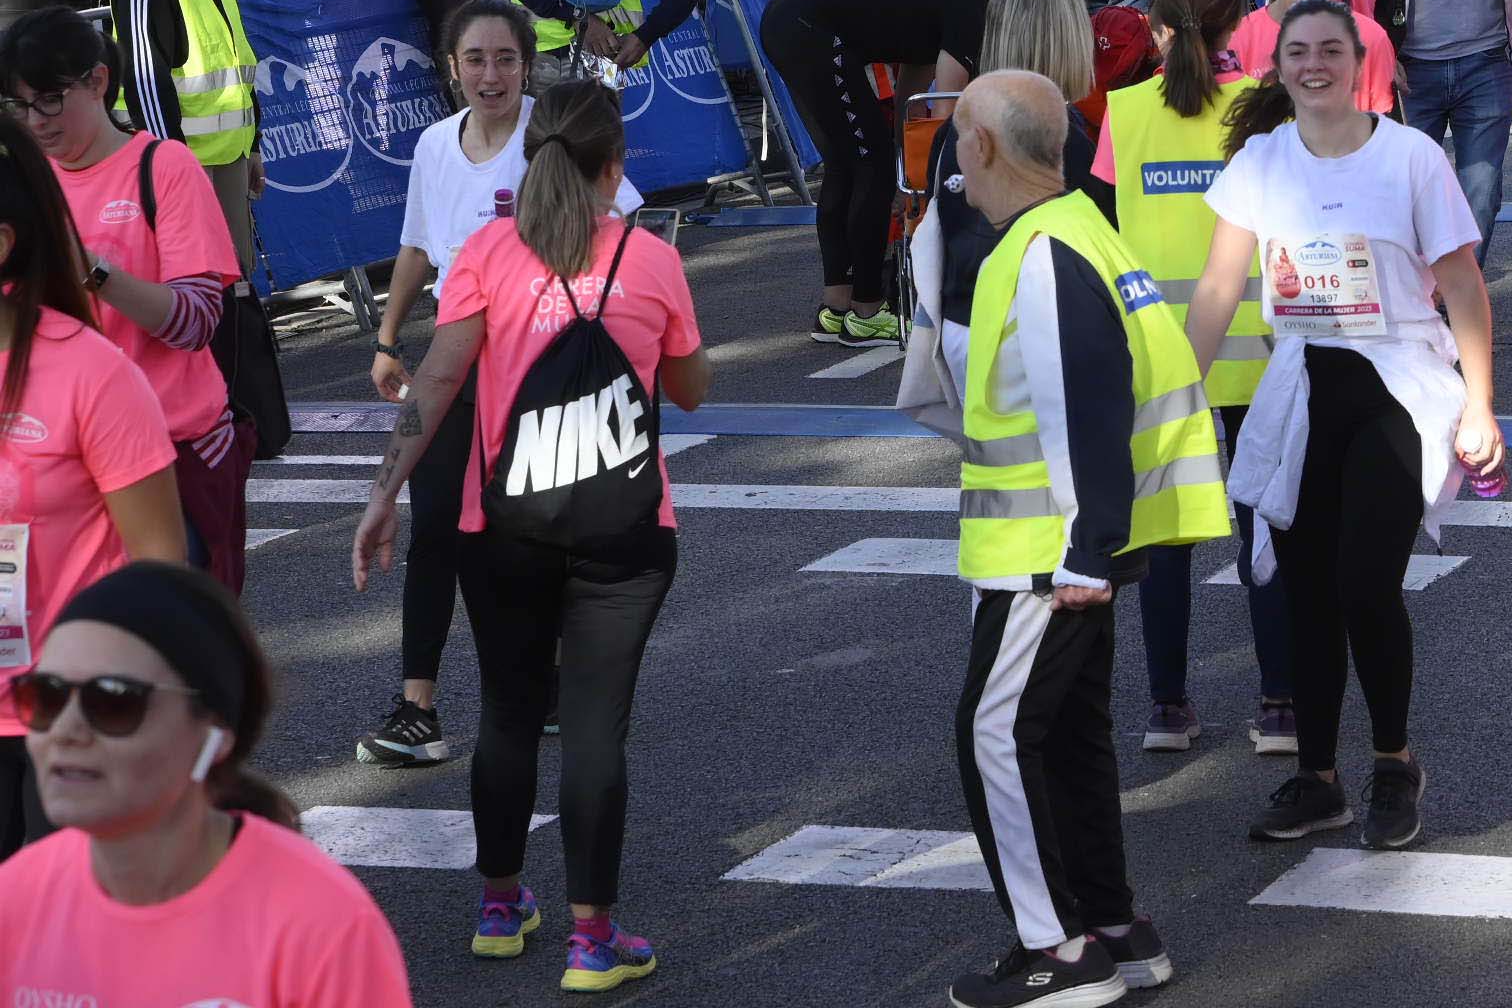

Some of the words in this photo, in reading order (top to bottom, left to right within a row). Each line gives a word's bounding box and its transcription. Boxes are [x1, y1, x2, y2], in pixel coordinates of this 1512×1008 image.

[1304, 274, 1341, 289] 016
[537, 295, 567, 315] DE
[1310, 293, 1338, 304] 13897
[506, 373, 651, 497] NIKE
